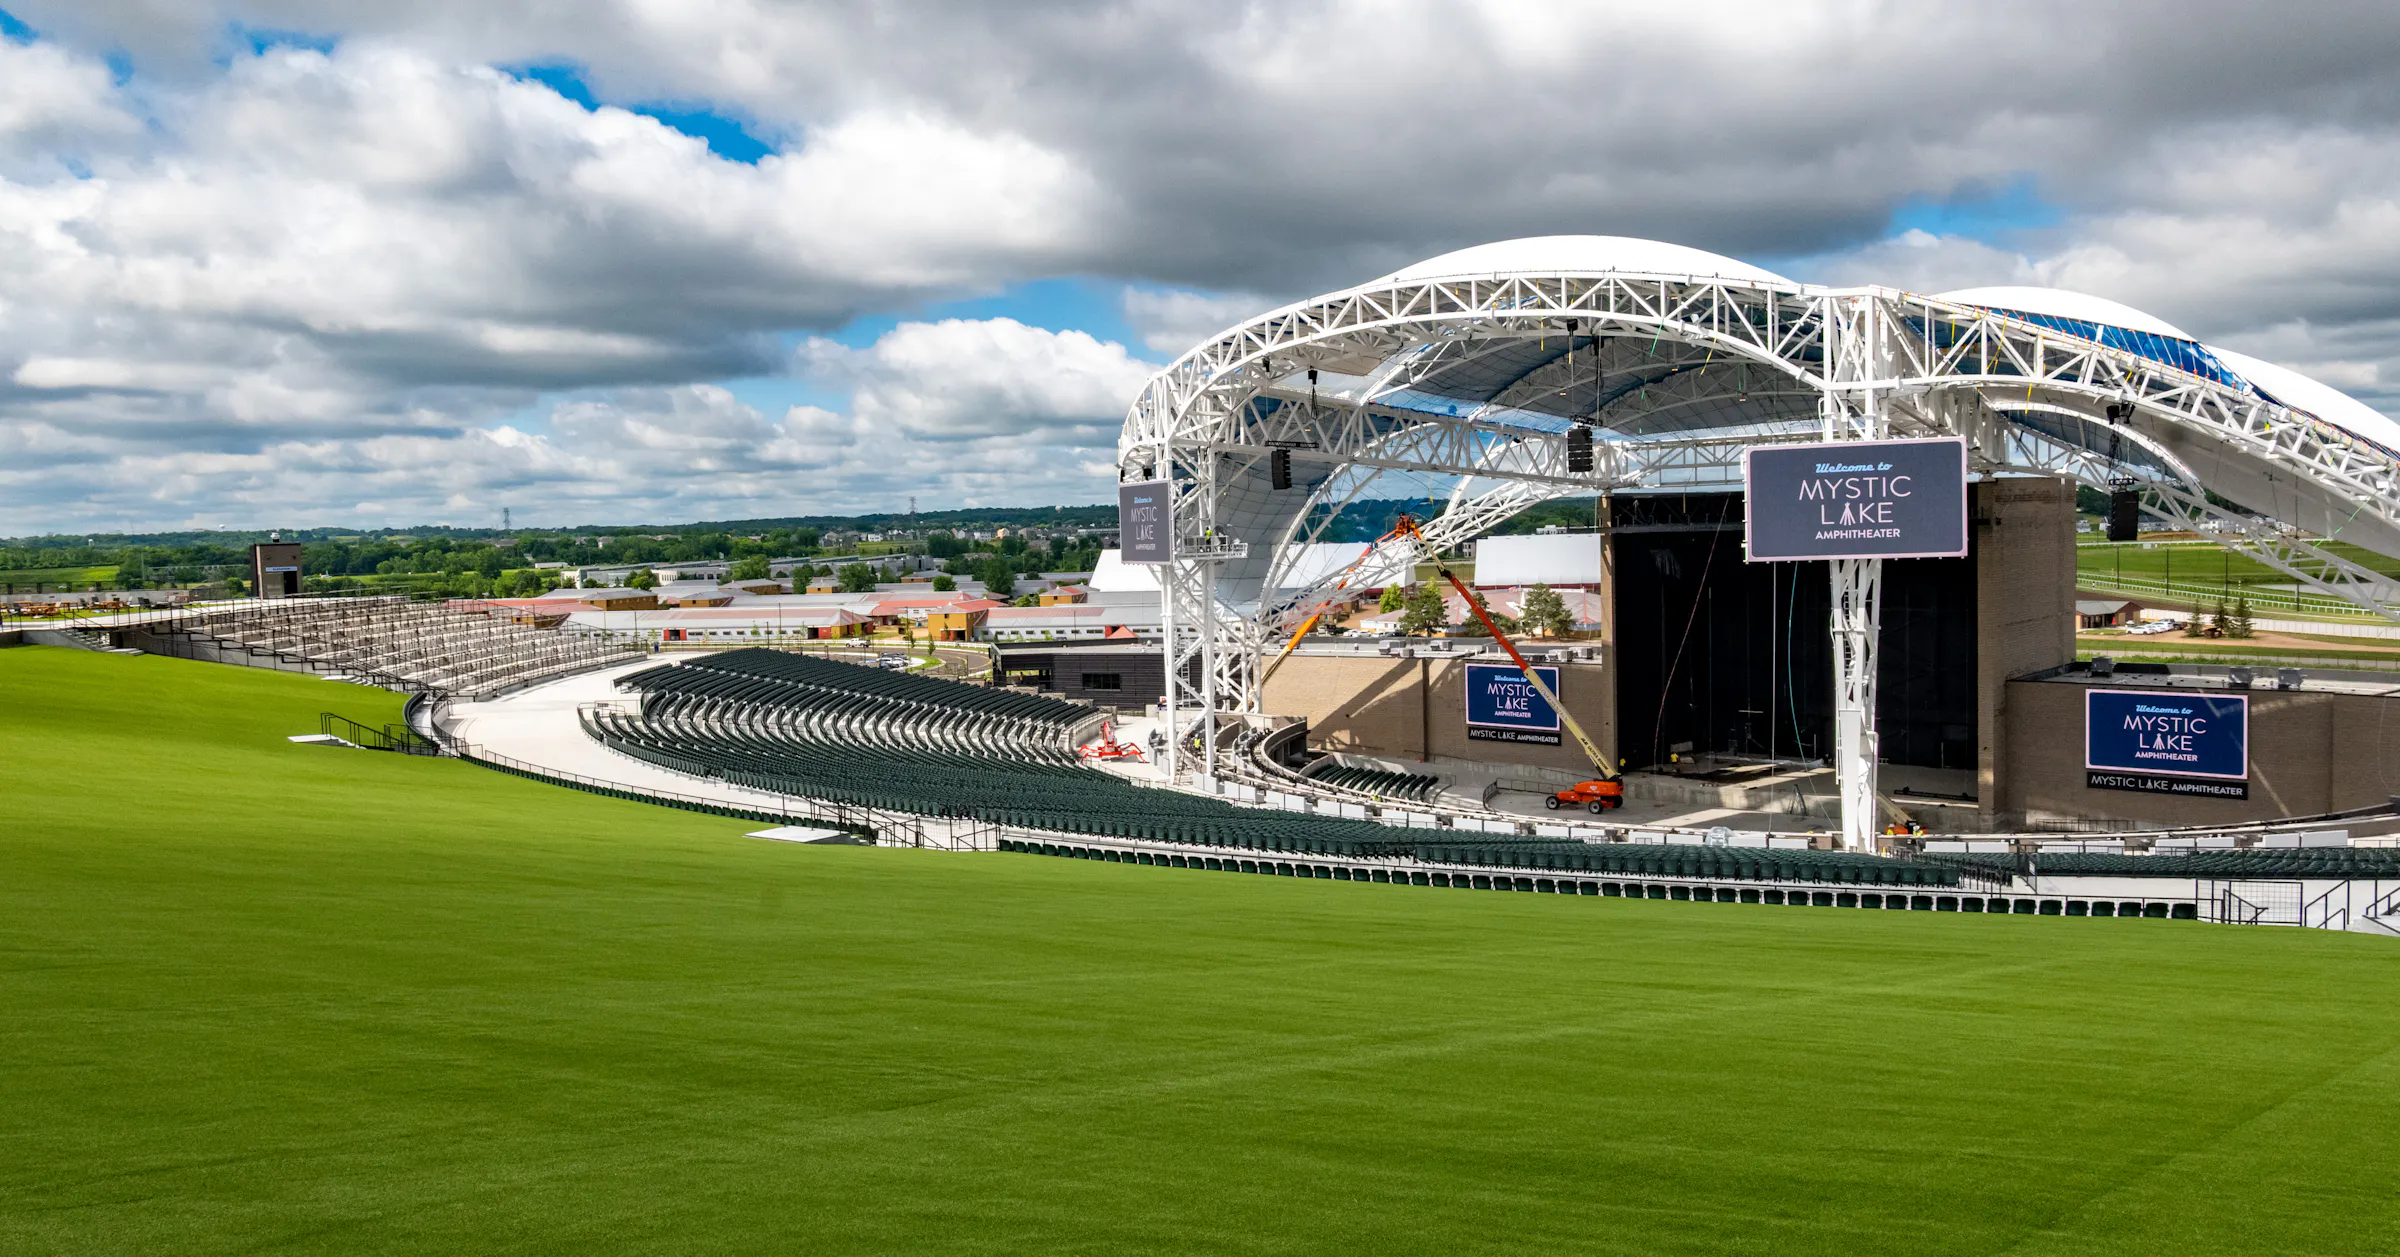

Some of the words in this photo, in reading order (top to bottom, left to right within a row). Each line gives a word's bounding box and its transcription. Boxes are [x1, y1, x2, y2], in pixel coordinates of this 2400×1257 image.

[1815, 462, 1875, 474] Welcome
[1877, 462, 1893, 472] to
[1799, 475, 1911, 500] MYSTIC
[1130, 506, 1157, 522] MYSTIC
[1821, 501, 1893, 526] LAKE
[1135, 525, 1154, 540] LAKE
[1815, 528, 1900, 540] AMPHITHEATER
[1487, 683, 1536, 697] MYSTIC
[1496, 696, 1528, 710] LAKE
[2135, 704, 2180, 714] Welcome
[2181, 707, 2193, 715] to
[2123, 714, 2207, 734] MYSTIC
[1470, 729, 1496, 738] MYSTIC
[1497, 731, 1516, 740] LAKE
[1517, 734, 1558, 743] AMPHITHEATER
[2139, 732, 2193, 751] LAKE
[2135, 751, 2198, 762] AMPHITHEATER
[2091, 774, 2135, 788] MYSTIC
[2138, 778, 2169, 790] LAKE
[2171, 783, 2243, 796] AMPHITHEATER
